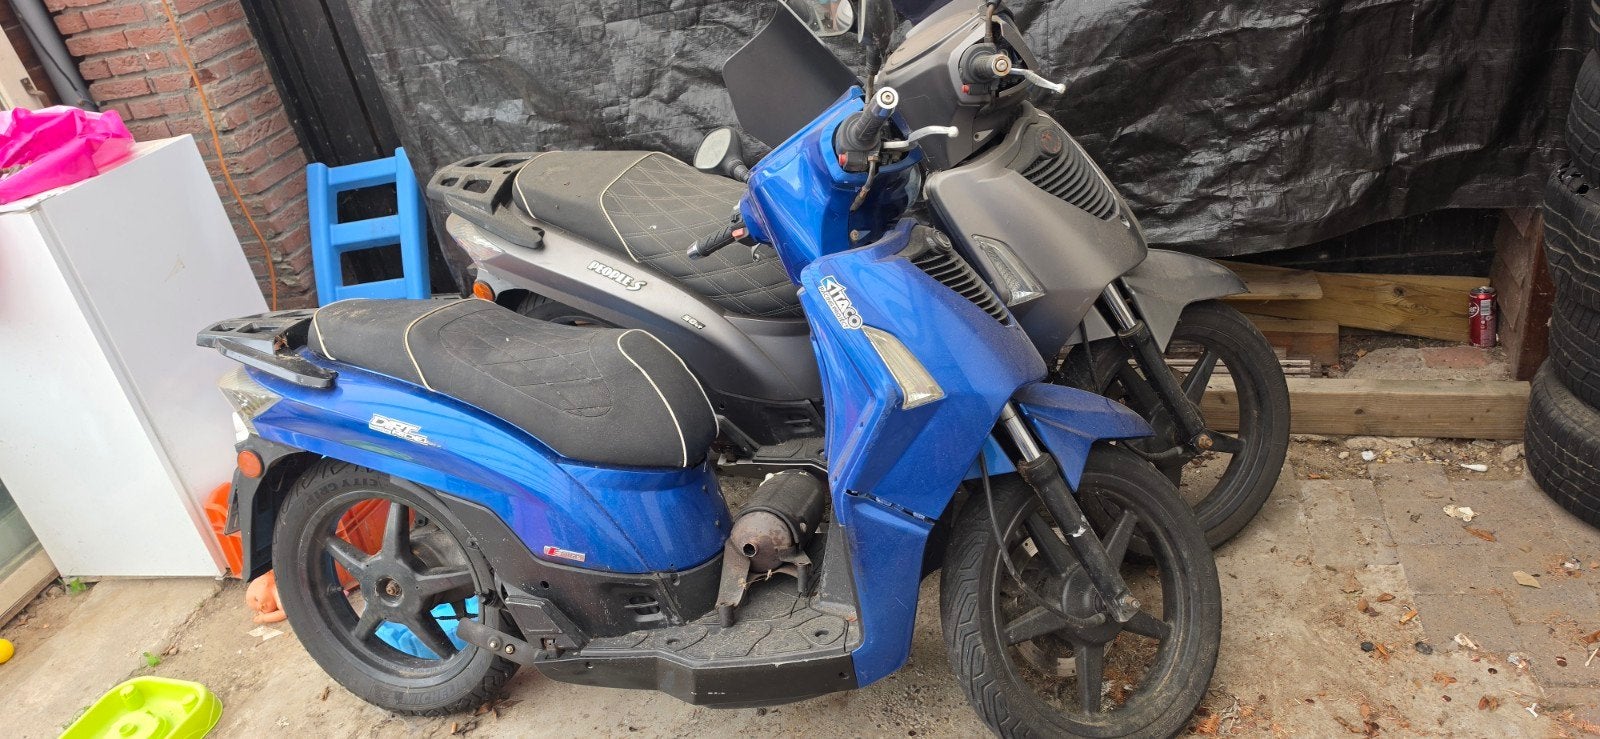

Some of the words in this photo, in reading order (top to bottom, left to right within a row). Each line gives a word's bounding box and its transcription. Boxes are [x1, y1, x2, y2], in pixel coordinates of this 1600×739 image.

[587, 260, 634, 287] PEOPLE
[626, 280, 648, 292] S
[371, 415, 420, 435] DIRT
[339, 476, 377, 489] CITY
